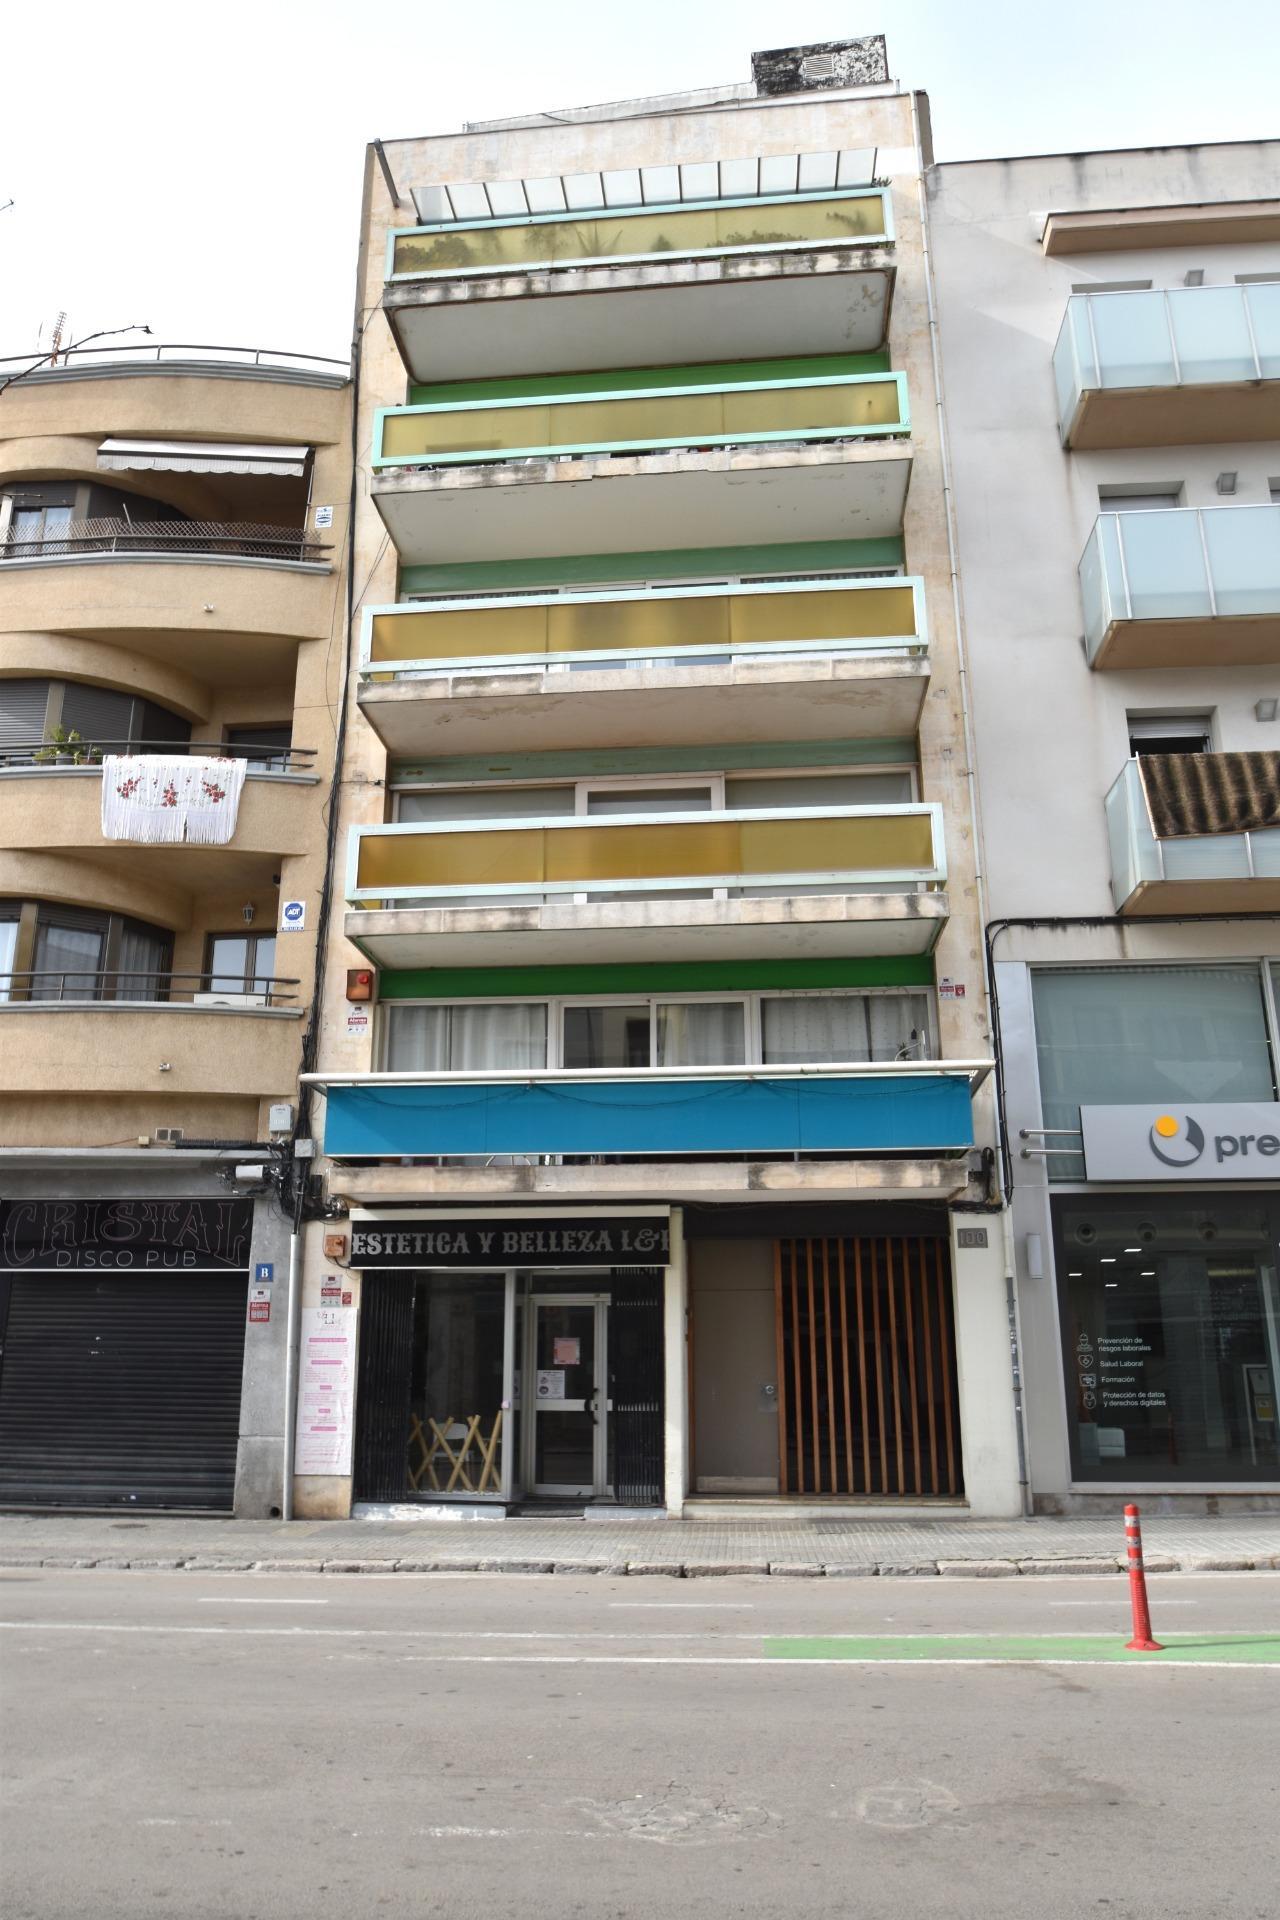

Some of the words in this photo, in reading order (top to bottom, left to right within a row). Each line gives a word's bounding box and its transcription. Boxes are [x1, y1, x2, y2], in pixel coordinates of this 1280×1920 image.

[3, 1202, 246, 1267] CRISTAL
[961, 1231, 985, 1244] 100
[352, 1231, 471, 1255] ESTETICA
[477, 1231, 496, 1254] Y
[502, 1230, 614, 1253] BELLEZA
[56, 1250, 134, 1267] DISCO
[146, 1250, 198, 1267] PUB
[261, 1267, 269, 1278] B
[1099, 1345, 1121, 1353] riesgos
